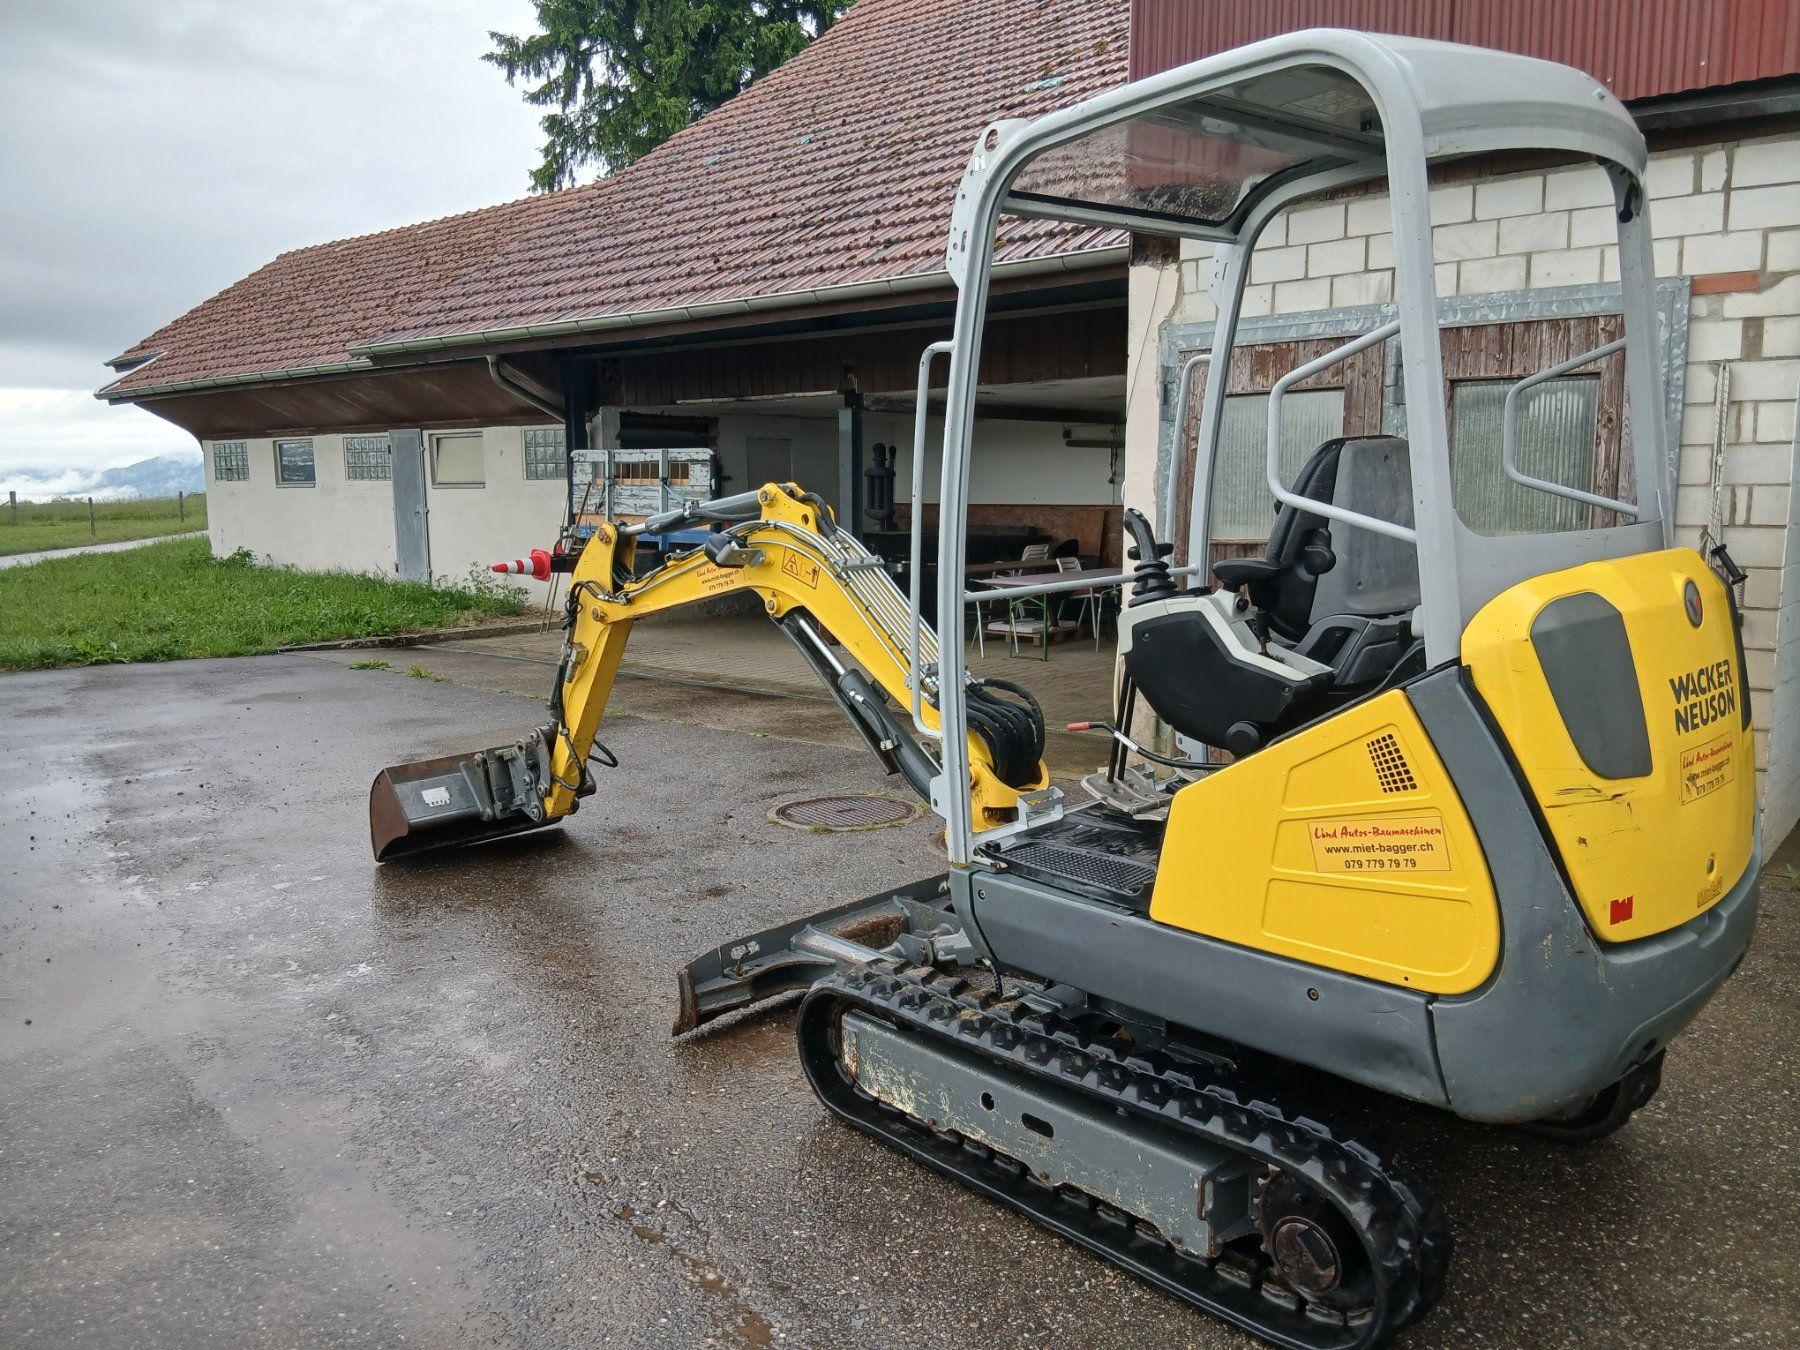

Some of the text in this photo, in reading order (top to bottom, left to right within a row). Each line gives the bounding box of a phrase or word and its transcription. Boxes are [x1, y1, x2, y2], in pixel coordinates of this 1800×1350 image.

[1668, 659, 1733, 704] WACKER
[1674, 686, 1736, 736] NEUSON
[1314, 825, 1442, 839] Lind Autos-Baumaschinen
[1325, 842, 1434, 854] www.miet-bagger.ch
[1344, 858, 1417, 869] 079 779 79 79
